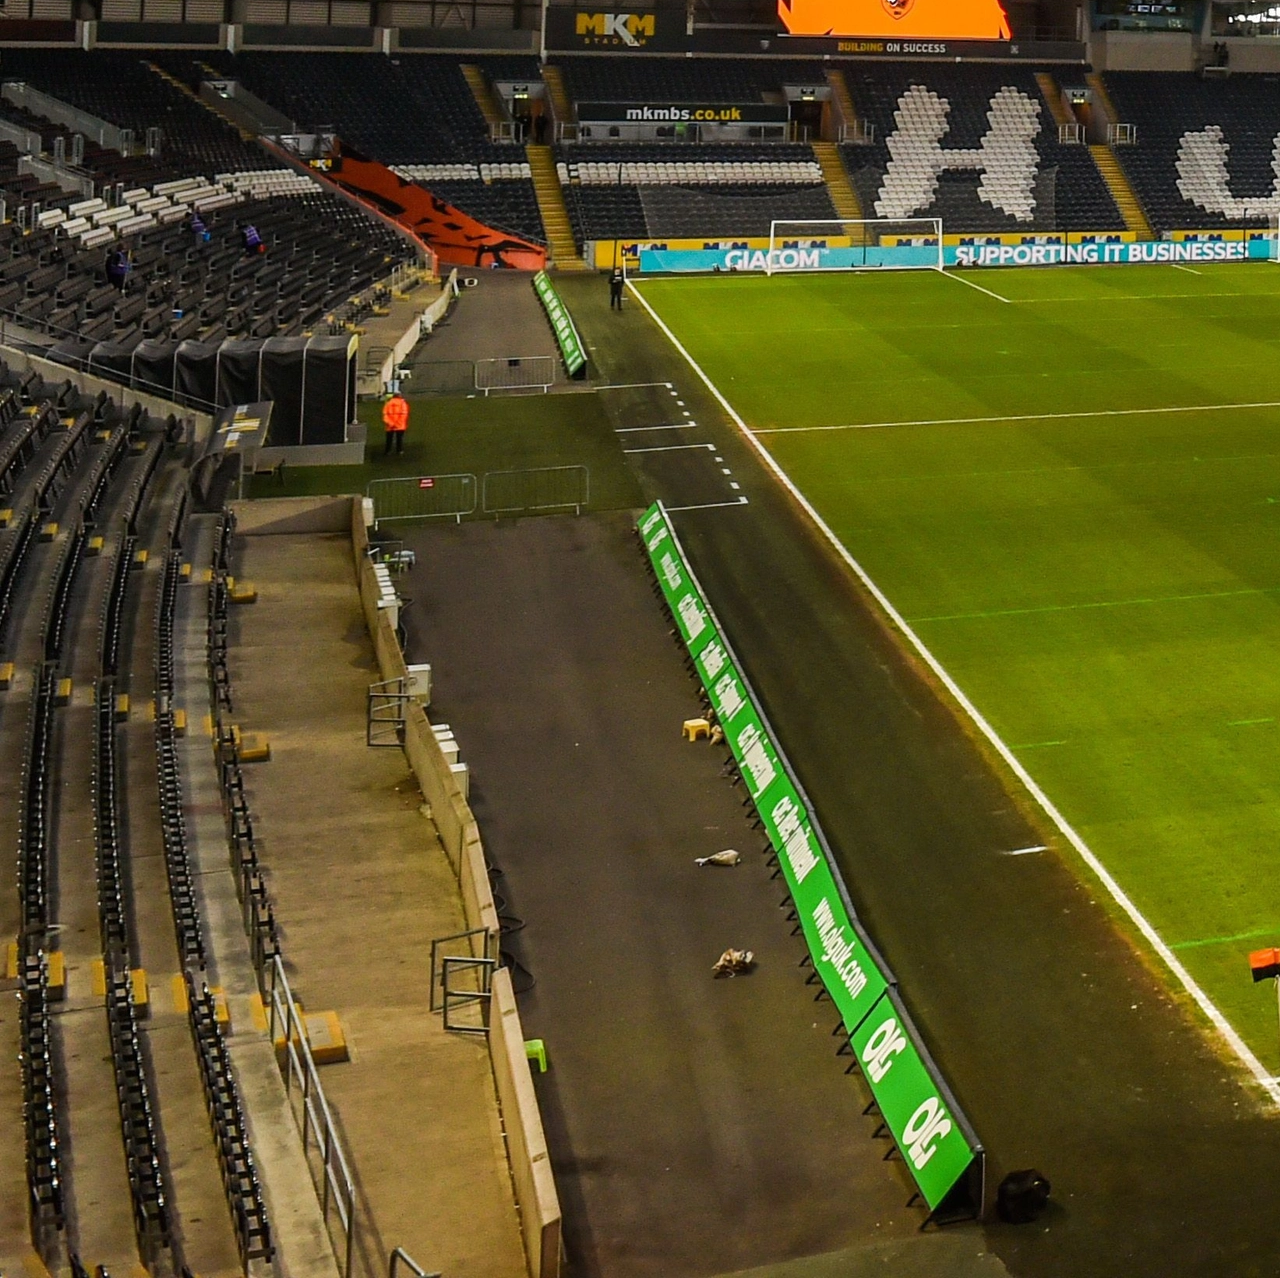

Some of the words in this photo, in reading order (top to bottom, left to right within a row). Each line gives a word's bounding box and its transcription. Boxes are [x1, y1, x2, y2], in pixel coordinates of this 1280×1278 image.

[576, 13, 655, 47] MKM
[838, 42, 883, 52] BUILDING
[886, 43, 900, 52] ON
[903, 43, 946, 53] SUCCESS
[626, 105, 742, 121] mkmbs.co.uk
[955, 245, 1099, 265] SUPPORTING
[1104, 244, 1125, 263] IT
[1128, 242, 1249, 263] BUSINESSES
[812, 896, 868, 1000] www.olguk.com
